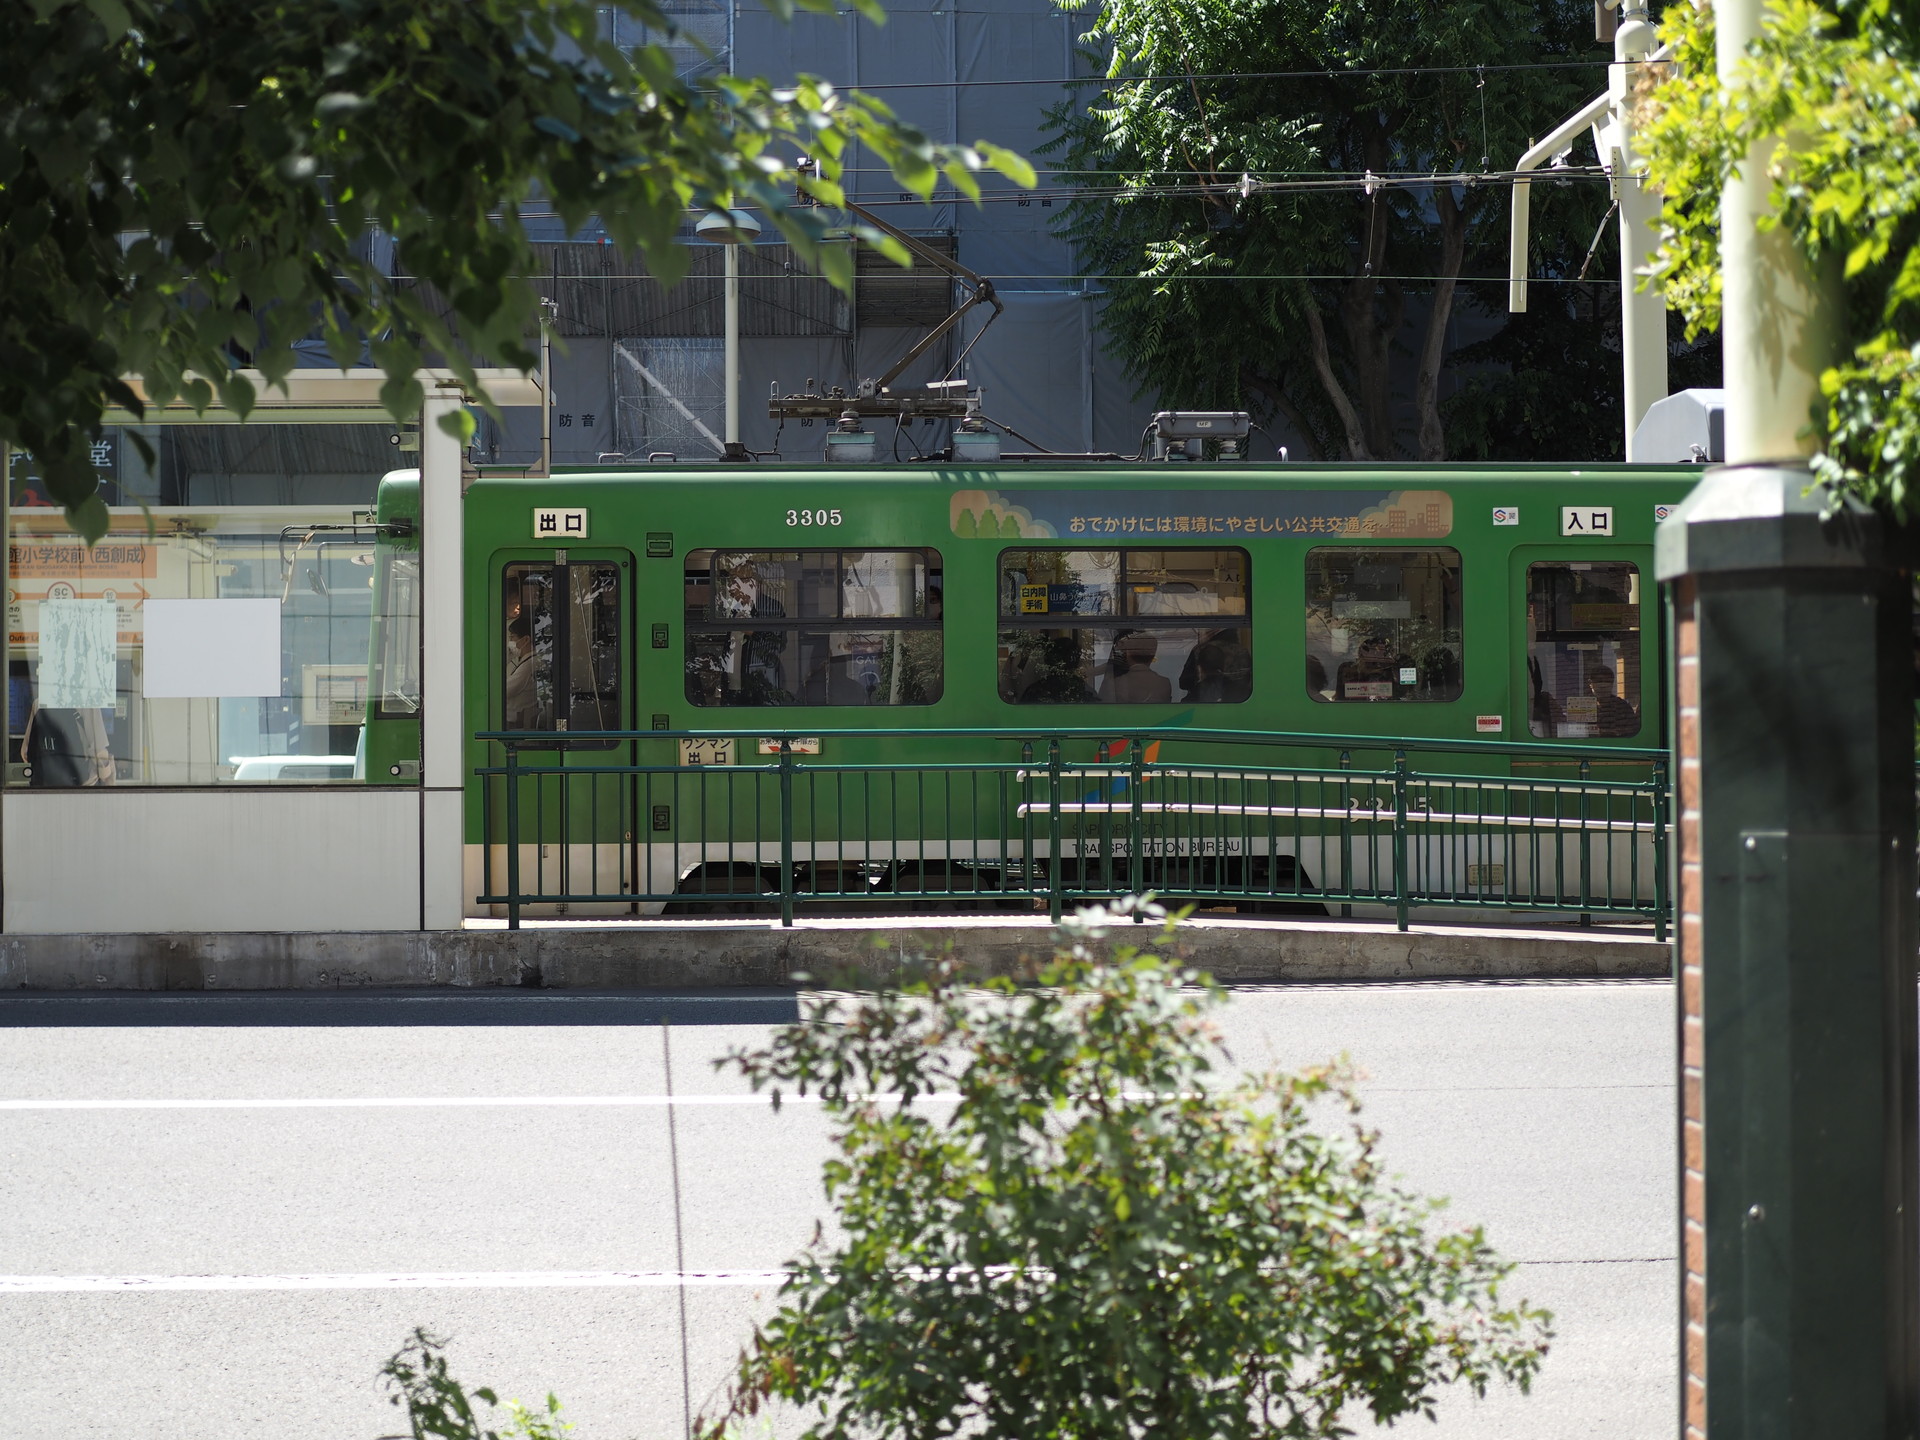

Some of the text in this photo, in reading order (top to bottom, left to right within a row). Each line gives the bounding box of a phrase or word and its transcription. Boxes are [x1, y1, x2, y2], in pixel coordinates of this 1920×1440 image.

[559, 414, 596, 428] 防音
[540, 513, 582, 532] 出口
[786, 508, 843, 527] 3305
[1568, 512, 1608, 530] 入口
[54, 588, 68, 597] SC
[682, 738, 731, 750] ワンマン
[688, 751, 726, 764] 出口
